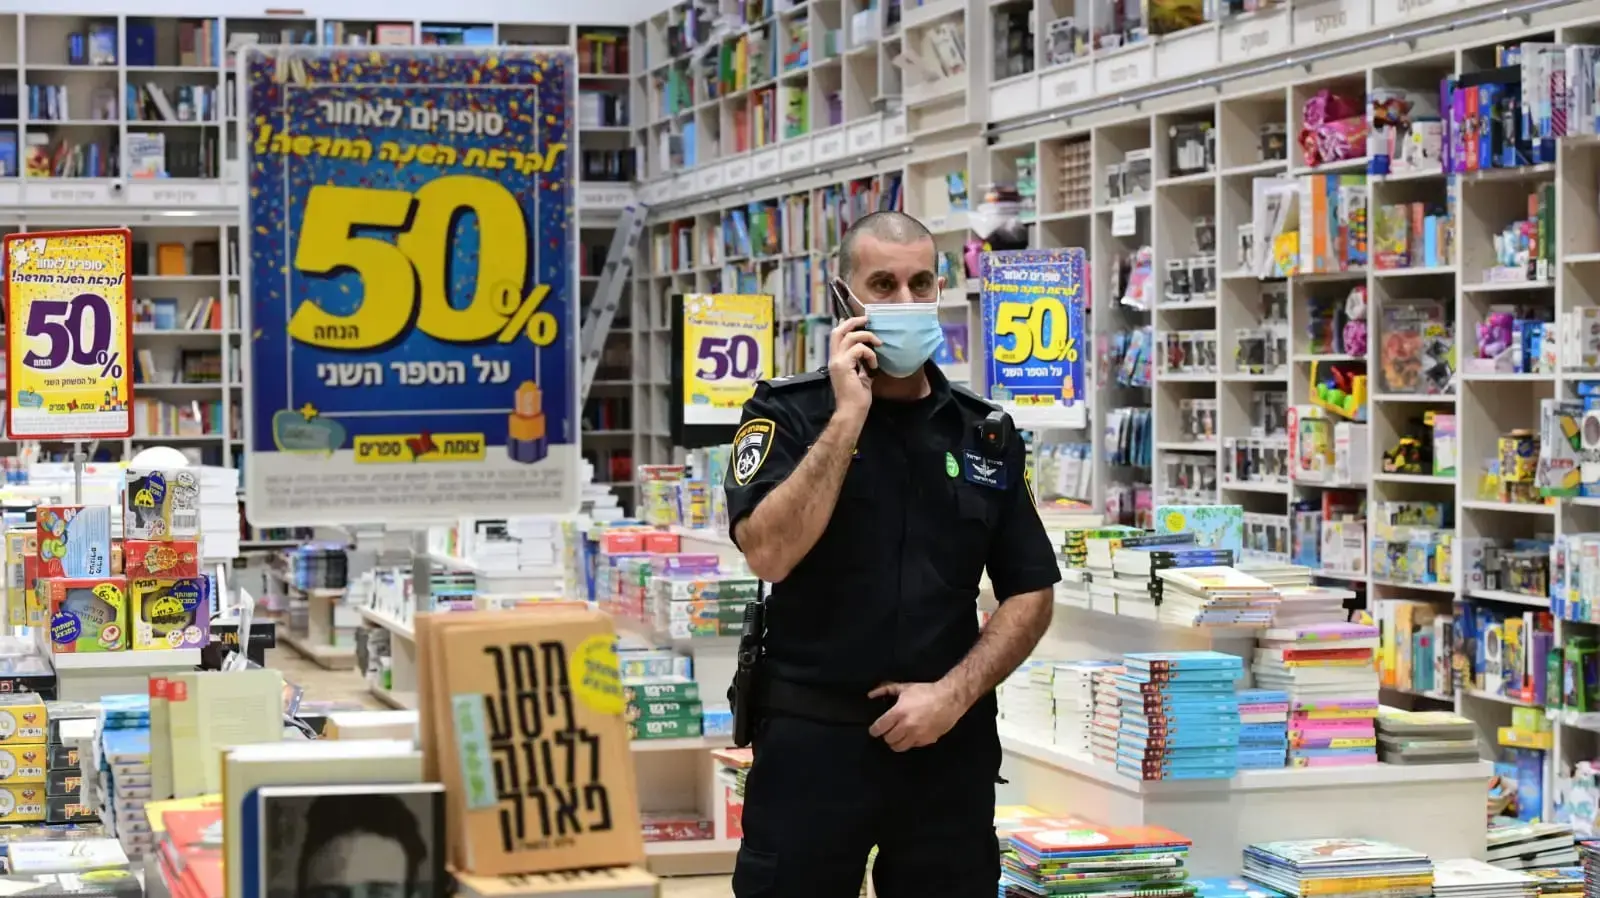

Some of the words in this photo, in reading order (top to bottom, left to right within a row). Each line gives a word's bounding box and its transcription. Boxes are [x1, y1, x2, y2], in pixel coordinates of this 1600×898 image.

[318, 98, 402, 127] לאחור
[411, 105, 504, 136] סופרים
[380, 142, 457, 165] השנה
[462, 142, 567, 175] לקראת
[36, 258, 67, 270] לאחור
[68, 260, 104, 272] סופרים
[287, 174, 559, 350] 50%
[56, 273, 85, 284] השנה
[88, 273, 125, 287] לקראת
[23, 293, 123, 379] 50%
[314, 325, 360, 341] הנחה
[994, 297, 1078, 364] 50%
[317, 361, 383, 387] השני
[390, 359, 466, 385] הספר
[472, 353, 511, 384] על
[359, 441, 402, 457] ספרים
[444, 437, 481, 455] צומת
[483, 640, 573, 693] מחר
[485, 690, 578, 744] ניסע
[492, 728, 600, 793] ללונה
[498, 784, 613, 853] פארק
